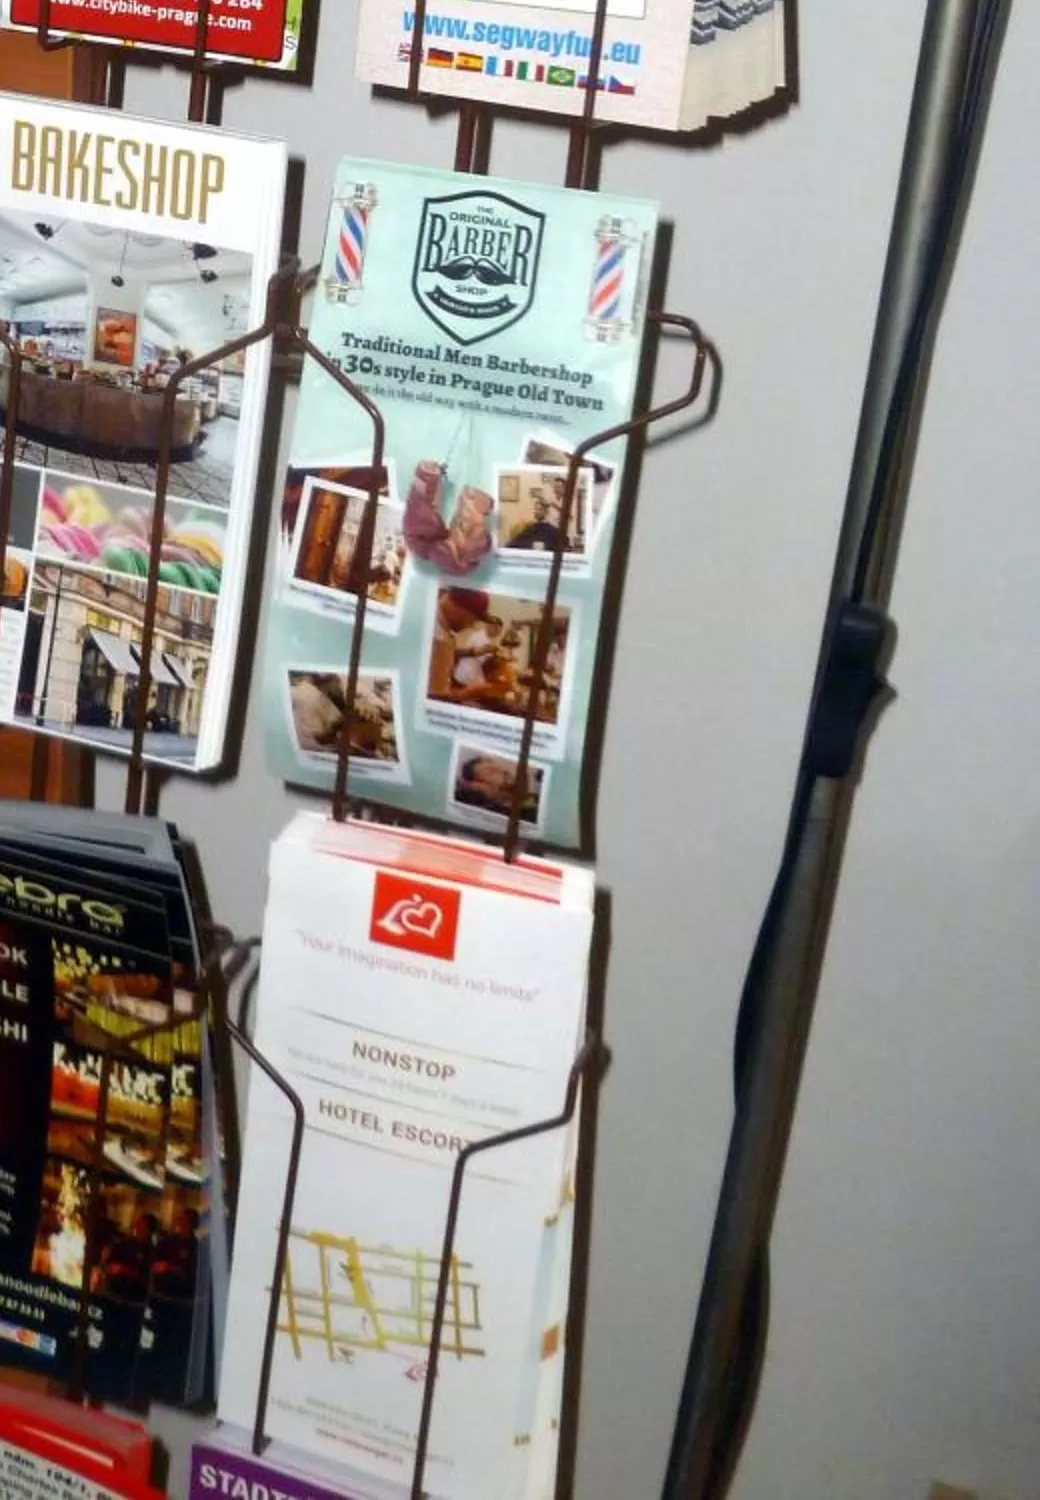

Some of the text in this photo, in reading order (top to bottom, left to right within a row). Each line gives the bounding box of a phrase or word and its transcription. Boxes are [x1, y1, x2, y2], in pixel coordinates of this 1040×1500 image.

[403, 7, 641, 66] www.segwayfu.eu
[12, 119, 224, 224] BAKESHOP
[449, 210, 512, 229] ORIGINAL
[422, 212, 533, 287] BARBER
[456, 285, 489, 297] SHOP
[341, 331, 594, 389] Traditional Men Barbershop
[384, 362, 426, 387] style
[428, 369, 448, 388] in
[450, 372, 515, 399] Prague
[518, 383, 548, 404] Old
[552, 389, 604, 412] Town
[352, 1039, 457, 1082] NONSTOP
[318, 1097, 385, 1133] HOTEL
